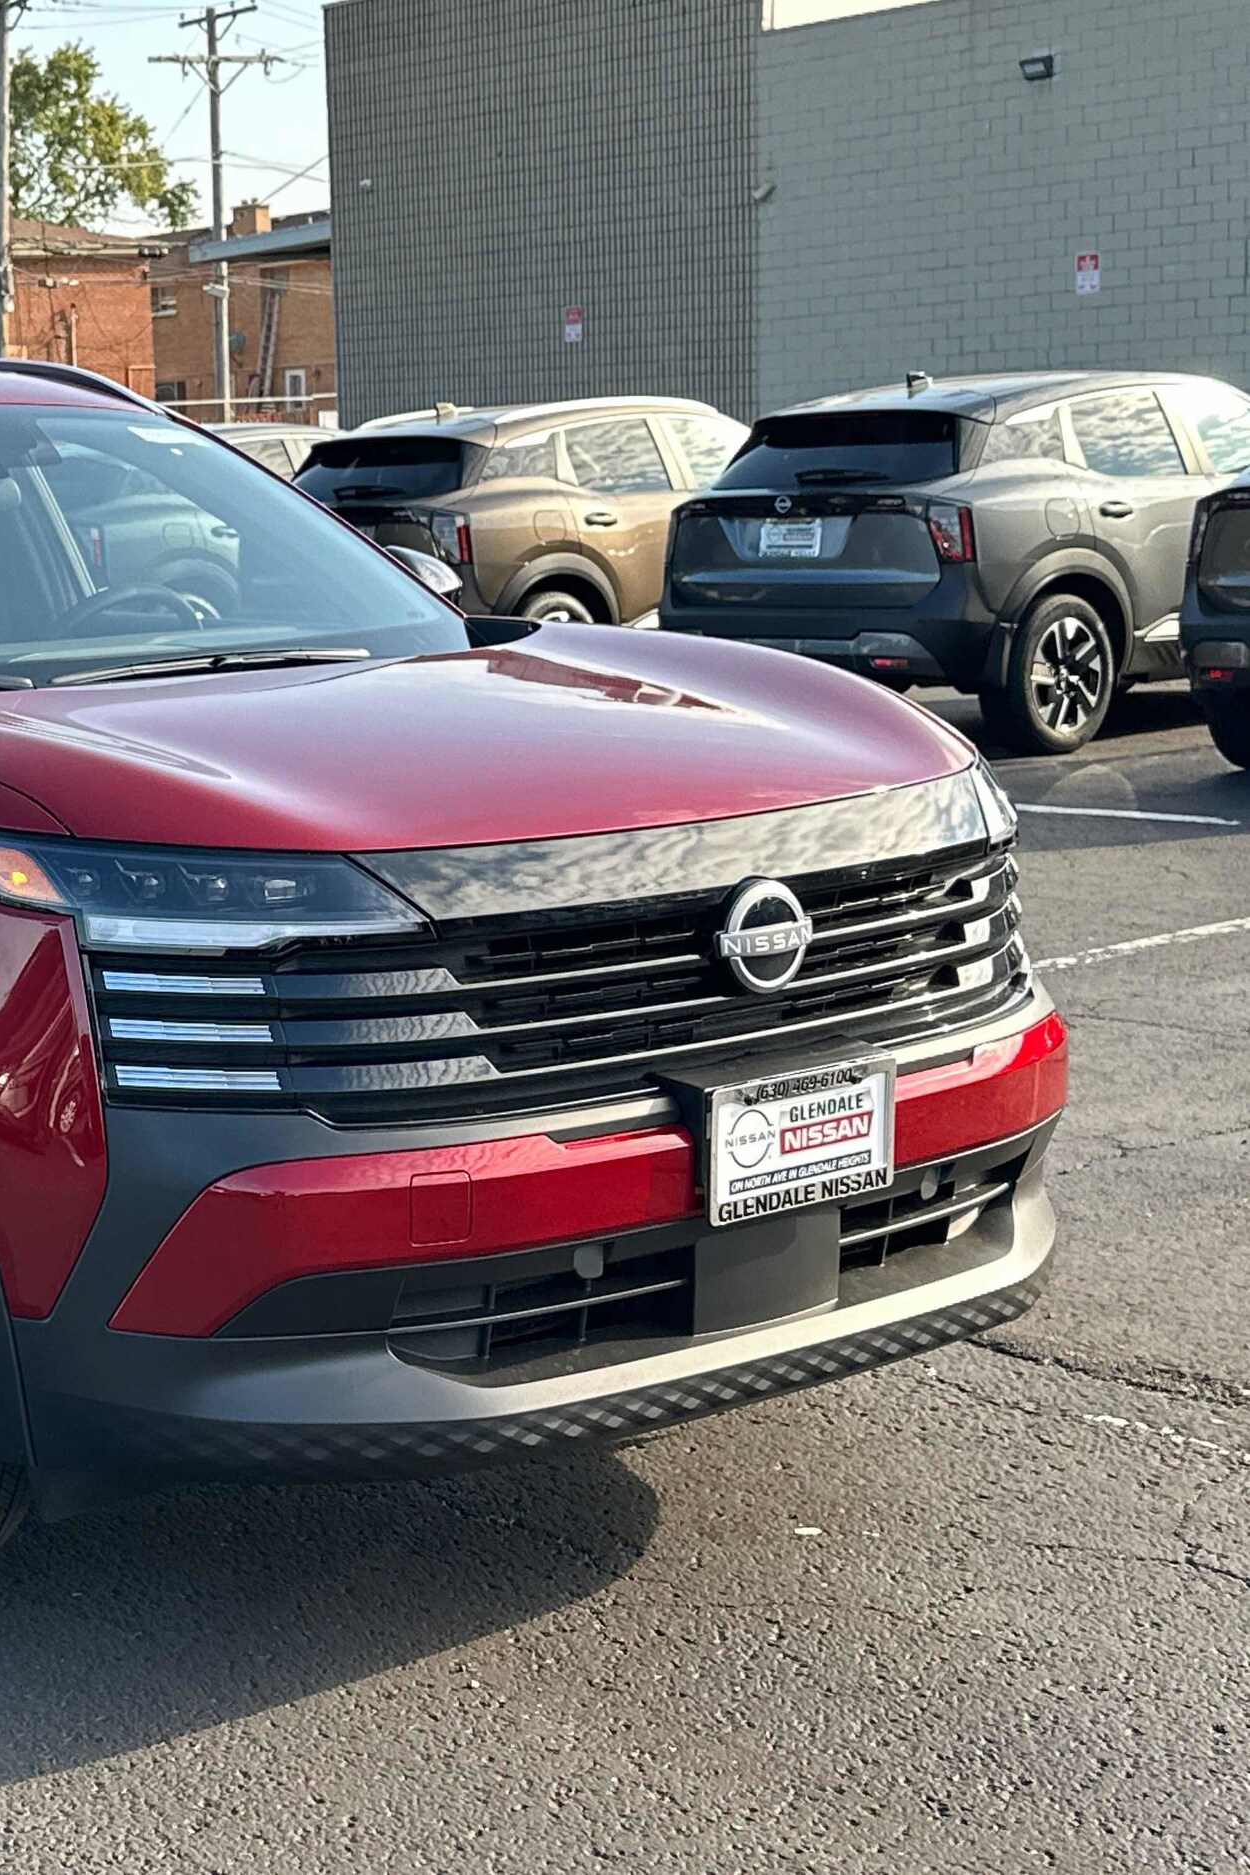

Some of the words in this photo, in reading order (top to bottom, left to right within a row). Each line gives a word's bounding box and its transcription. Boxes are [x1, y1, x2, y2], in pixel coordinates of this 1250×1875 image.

[724, 926, 811, 955] NISSAN
[757, 1080, 790, 1101] (630)
[792, 1068, 854, 1092] 469-6100
[789, 1093, 864, 1123] GLENDALE
[724, 1130, 776, 1149] NISSAN
[784, 1120, 869, 1151] NISSAN
[719, 1183, 816, 1222] GLENDALE
[821, 1168, 888, 1199] NISSAN
